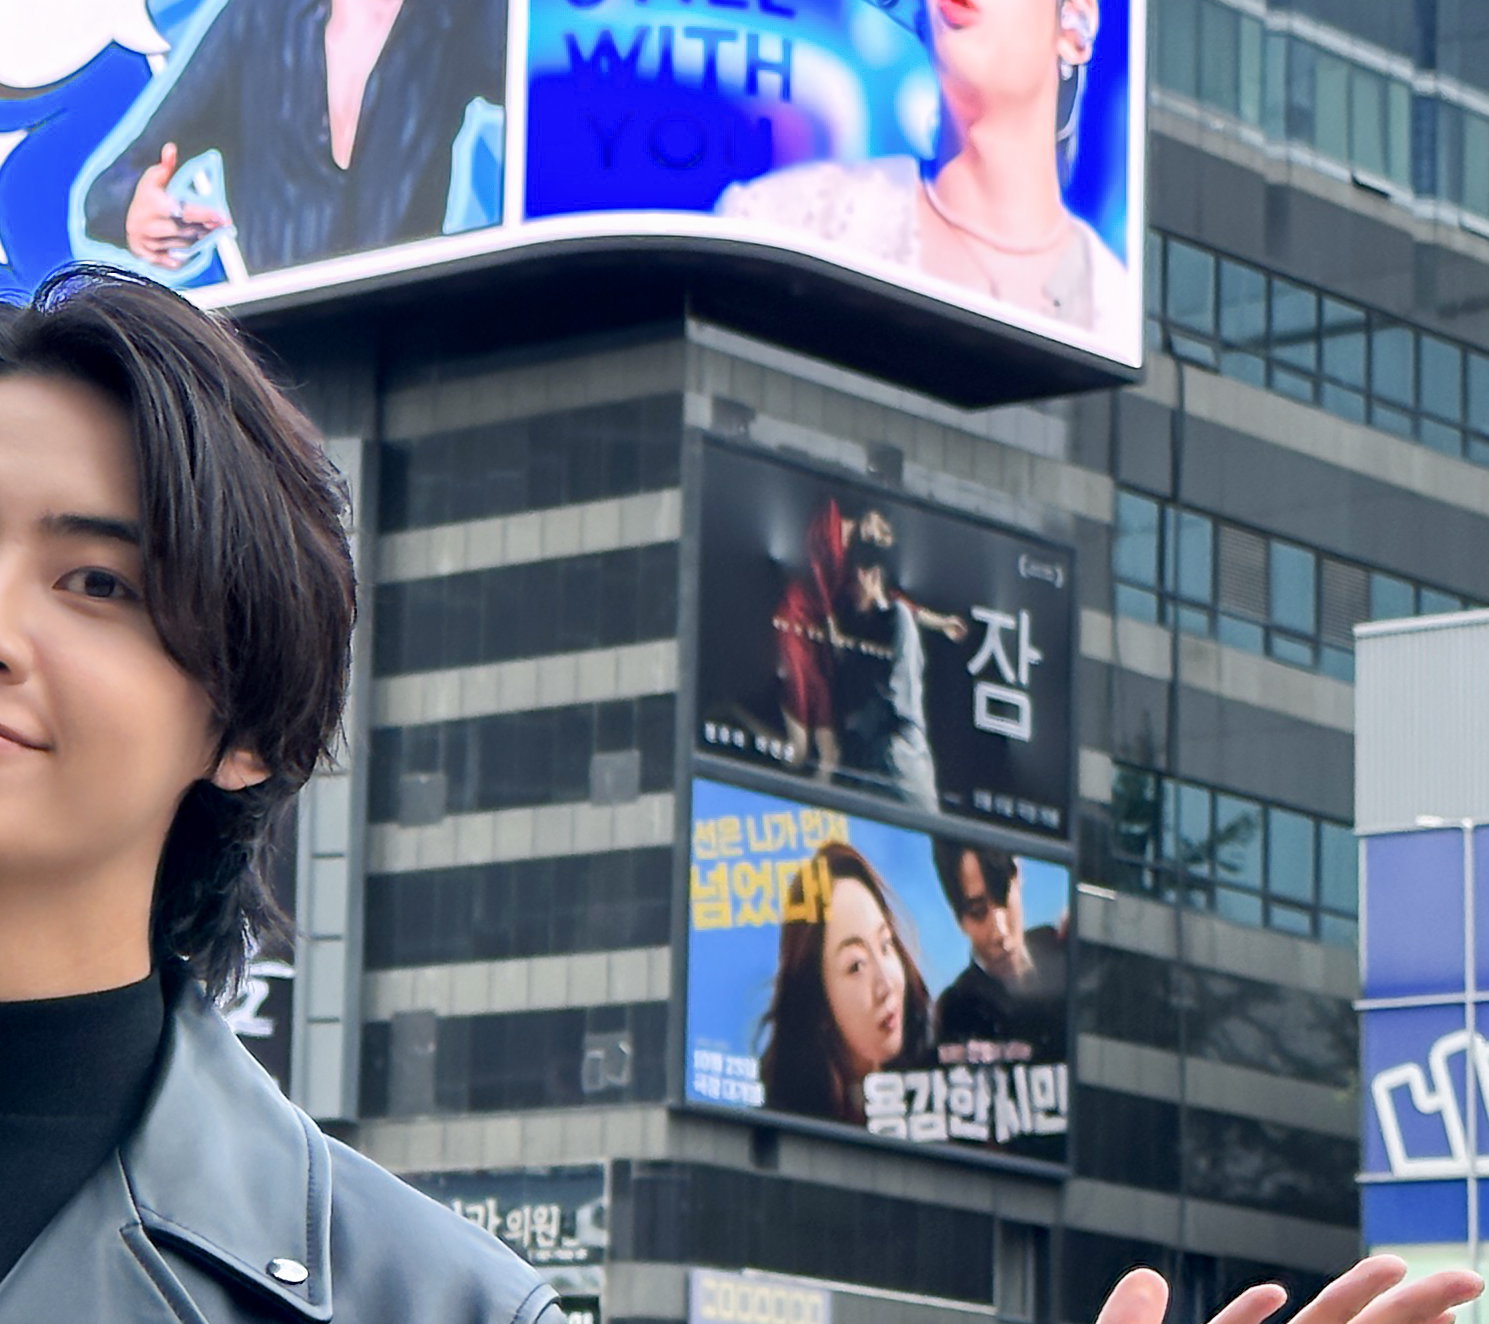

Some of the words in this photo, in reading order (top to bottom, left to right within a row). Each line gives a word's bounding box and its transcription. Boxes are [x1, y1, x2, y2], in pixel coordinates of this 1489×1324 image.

[563, 26, 792, 104] WITH
[966, 605, 1044, 744] 잠
[690, 856, 834, 931] 넘었다!
